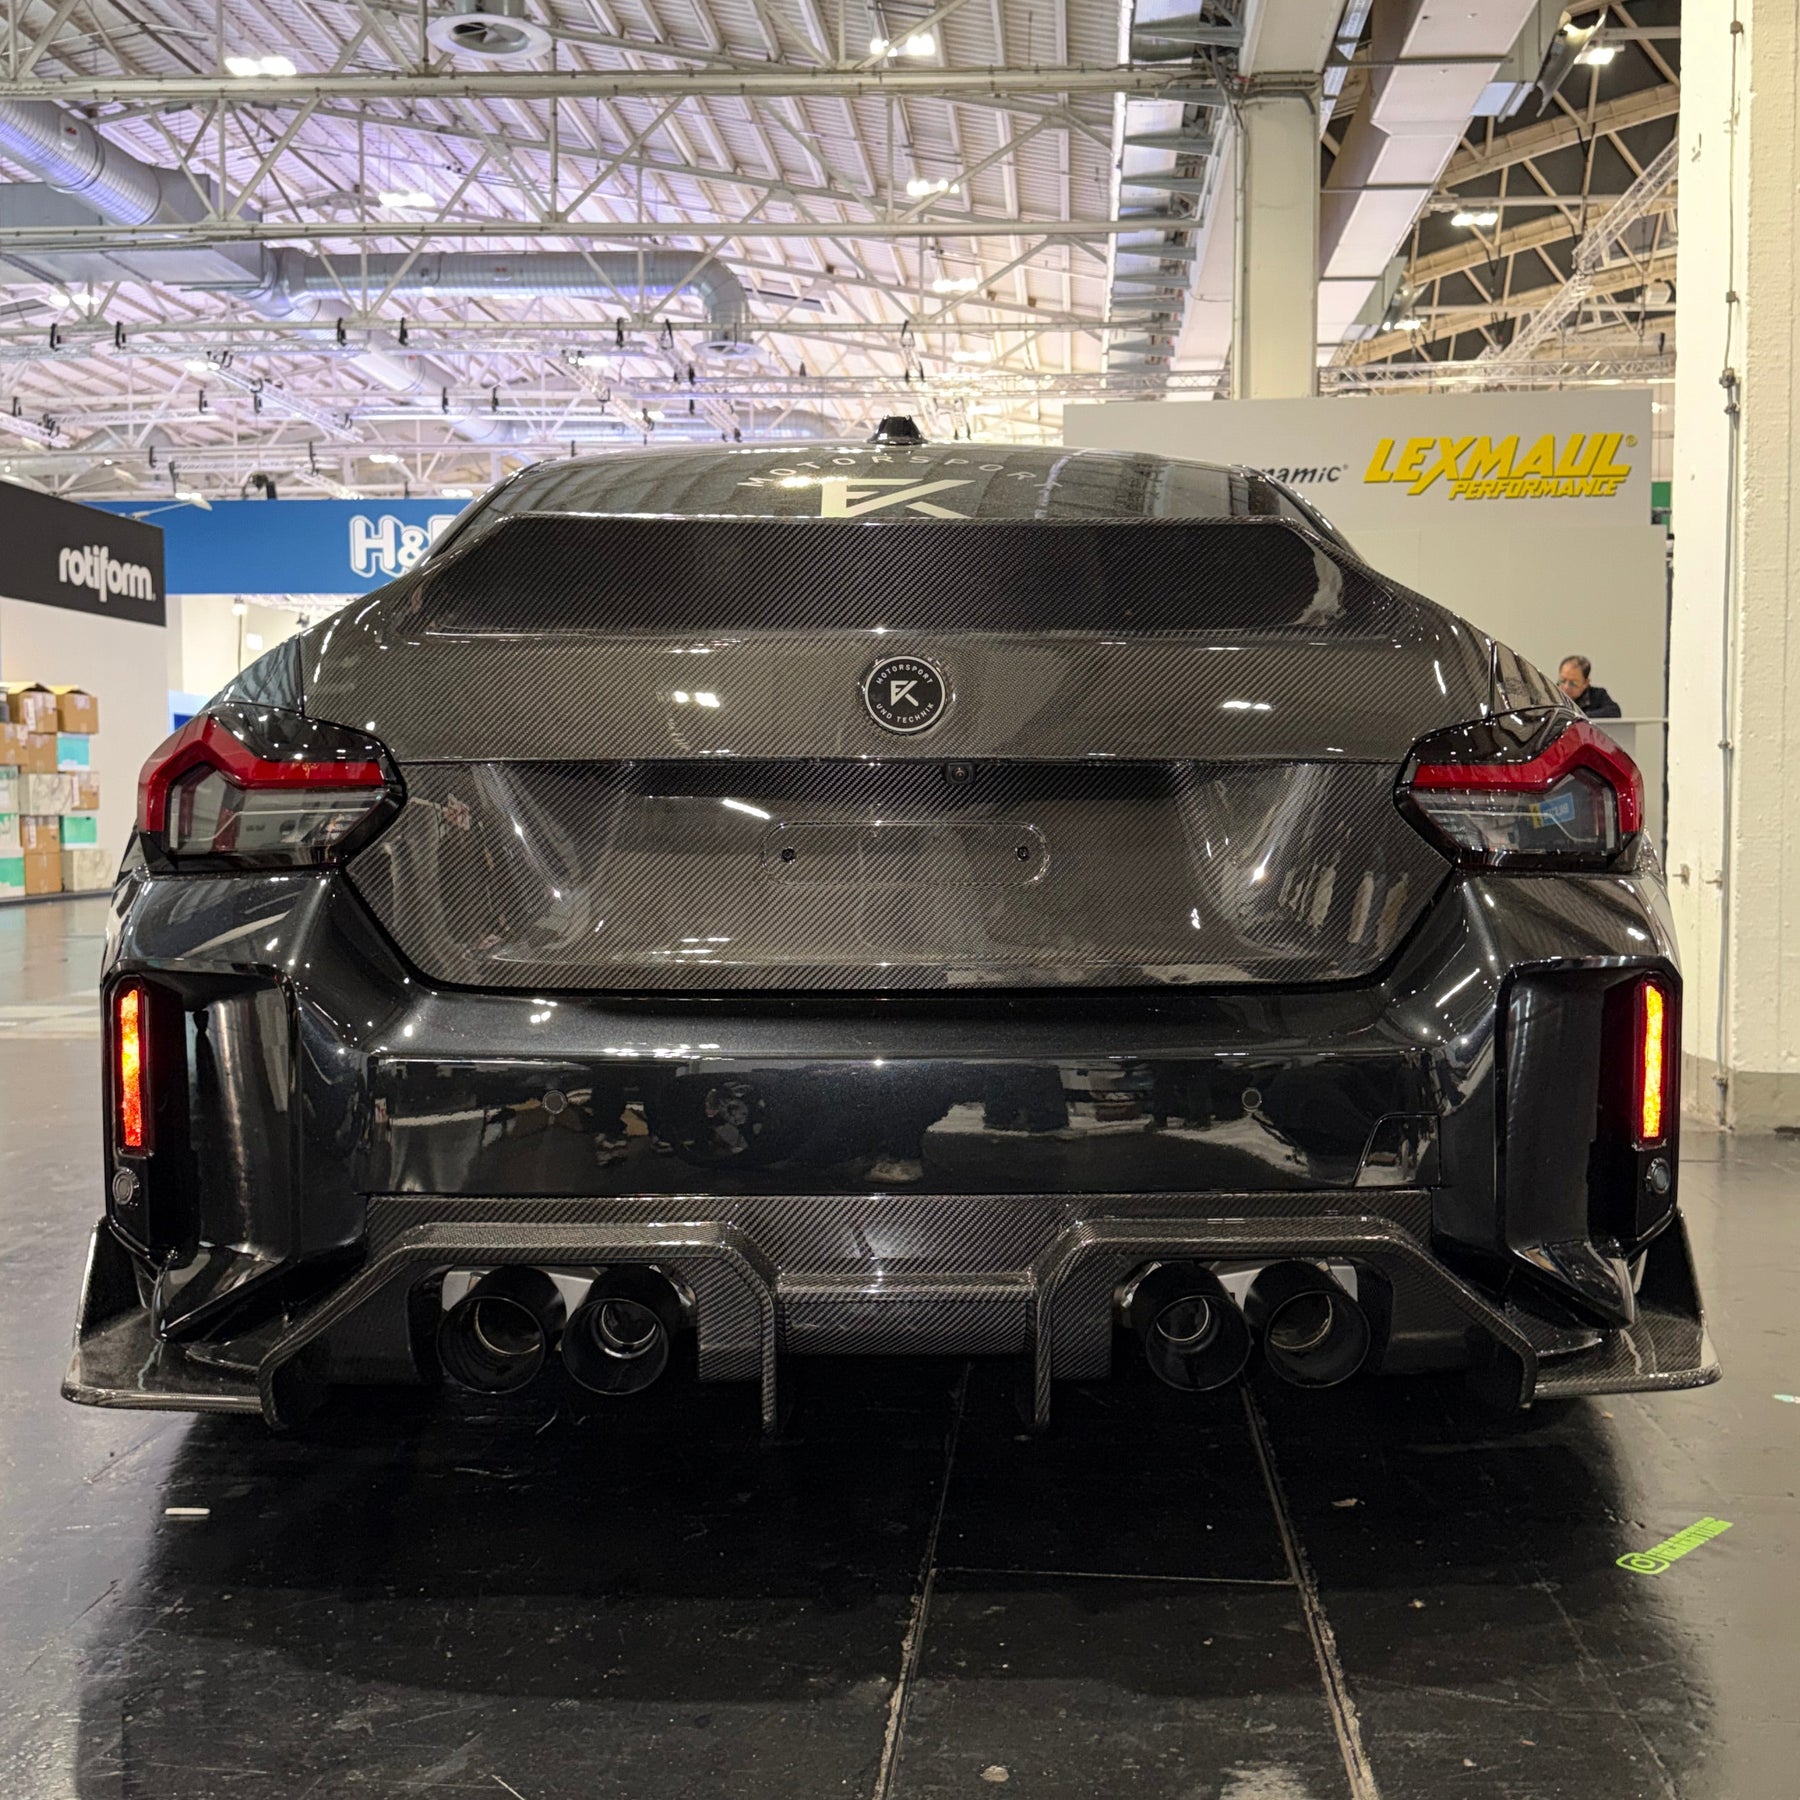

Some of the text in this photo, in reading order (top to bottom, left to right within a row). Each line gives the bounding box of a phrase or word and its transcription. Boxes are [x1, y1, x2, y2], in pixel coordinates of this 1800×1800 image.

[737, 455, 1063, 488] MOTORSPORT
[1363, 433, 1632, 495] LEXMAUL
[1448, 476, 1627, 501] PERFORMANCE
[59, 544, 154, 603] rotiform
[875, 663, 934, 685] MOTORSPORT
[876, 702, 935, 723] UND TECHNIK
